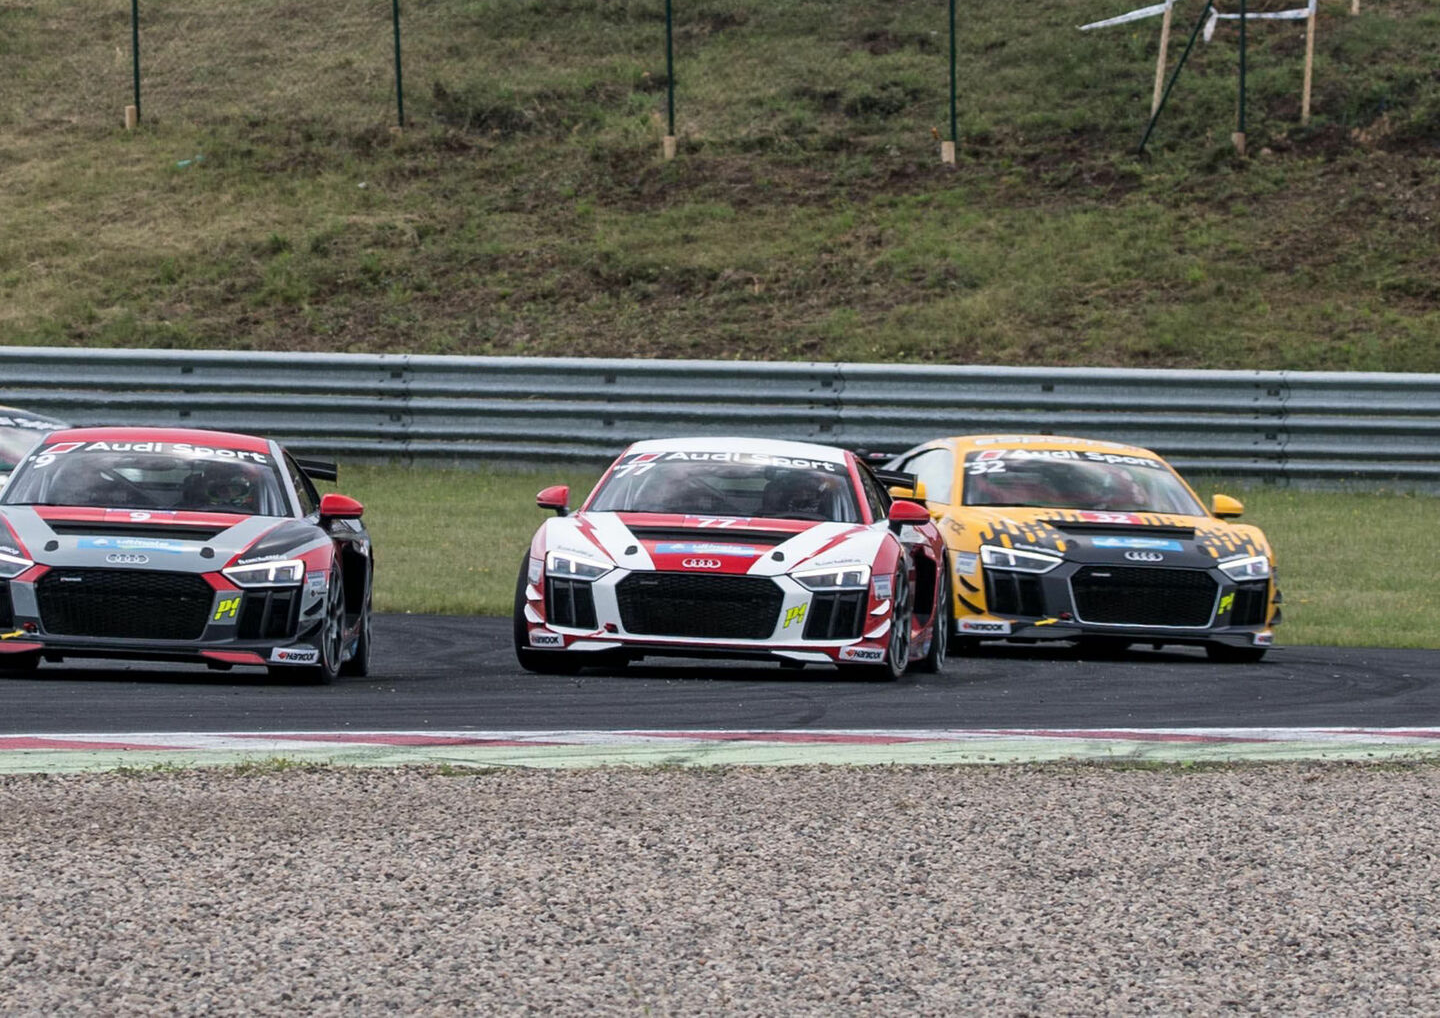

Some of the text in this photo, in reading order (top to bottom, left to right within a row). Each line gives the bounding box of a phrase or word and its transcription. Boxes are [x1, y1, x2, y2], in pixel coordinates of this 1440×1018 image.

[85, 441, 267, 464] Audi Sport
[1011, 449, 1159, 469] Audi Sport
[35, 453, 56, 470] 9
[667, 451, 835, 472] Audi Sport
[969, 460, 1007, 475] 32
[617, 462, 657, 479] 77
[129, 511, 152, 522] 9
[695, 518, 737, 529] 77
[1096, 512, 1131, 524] 32
